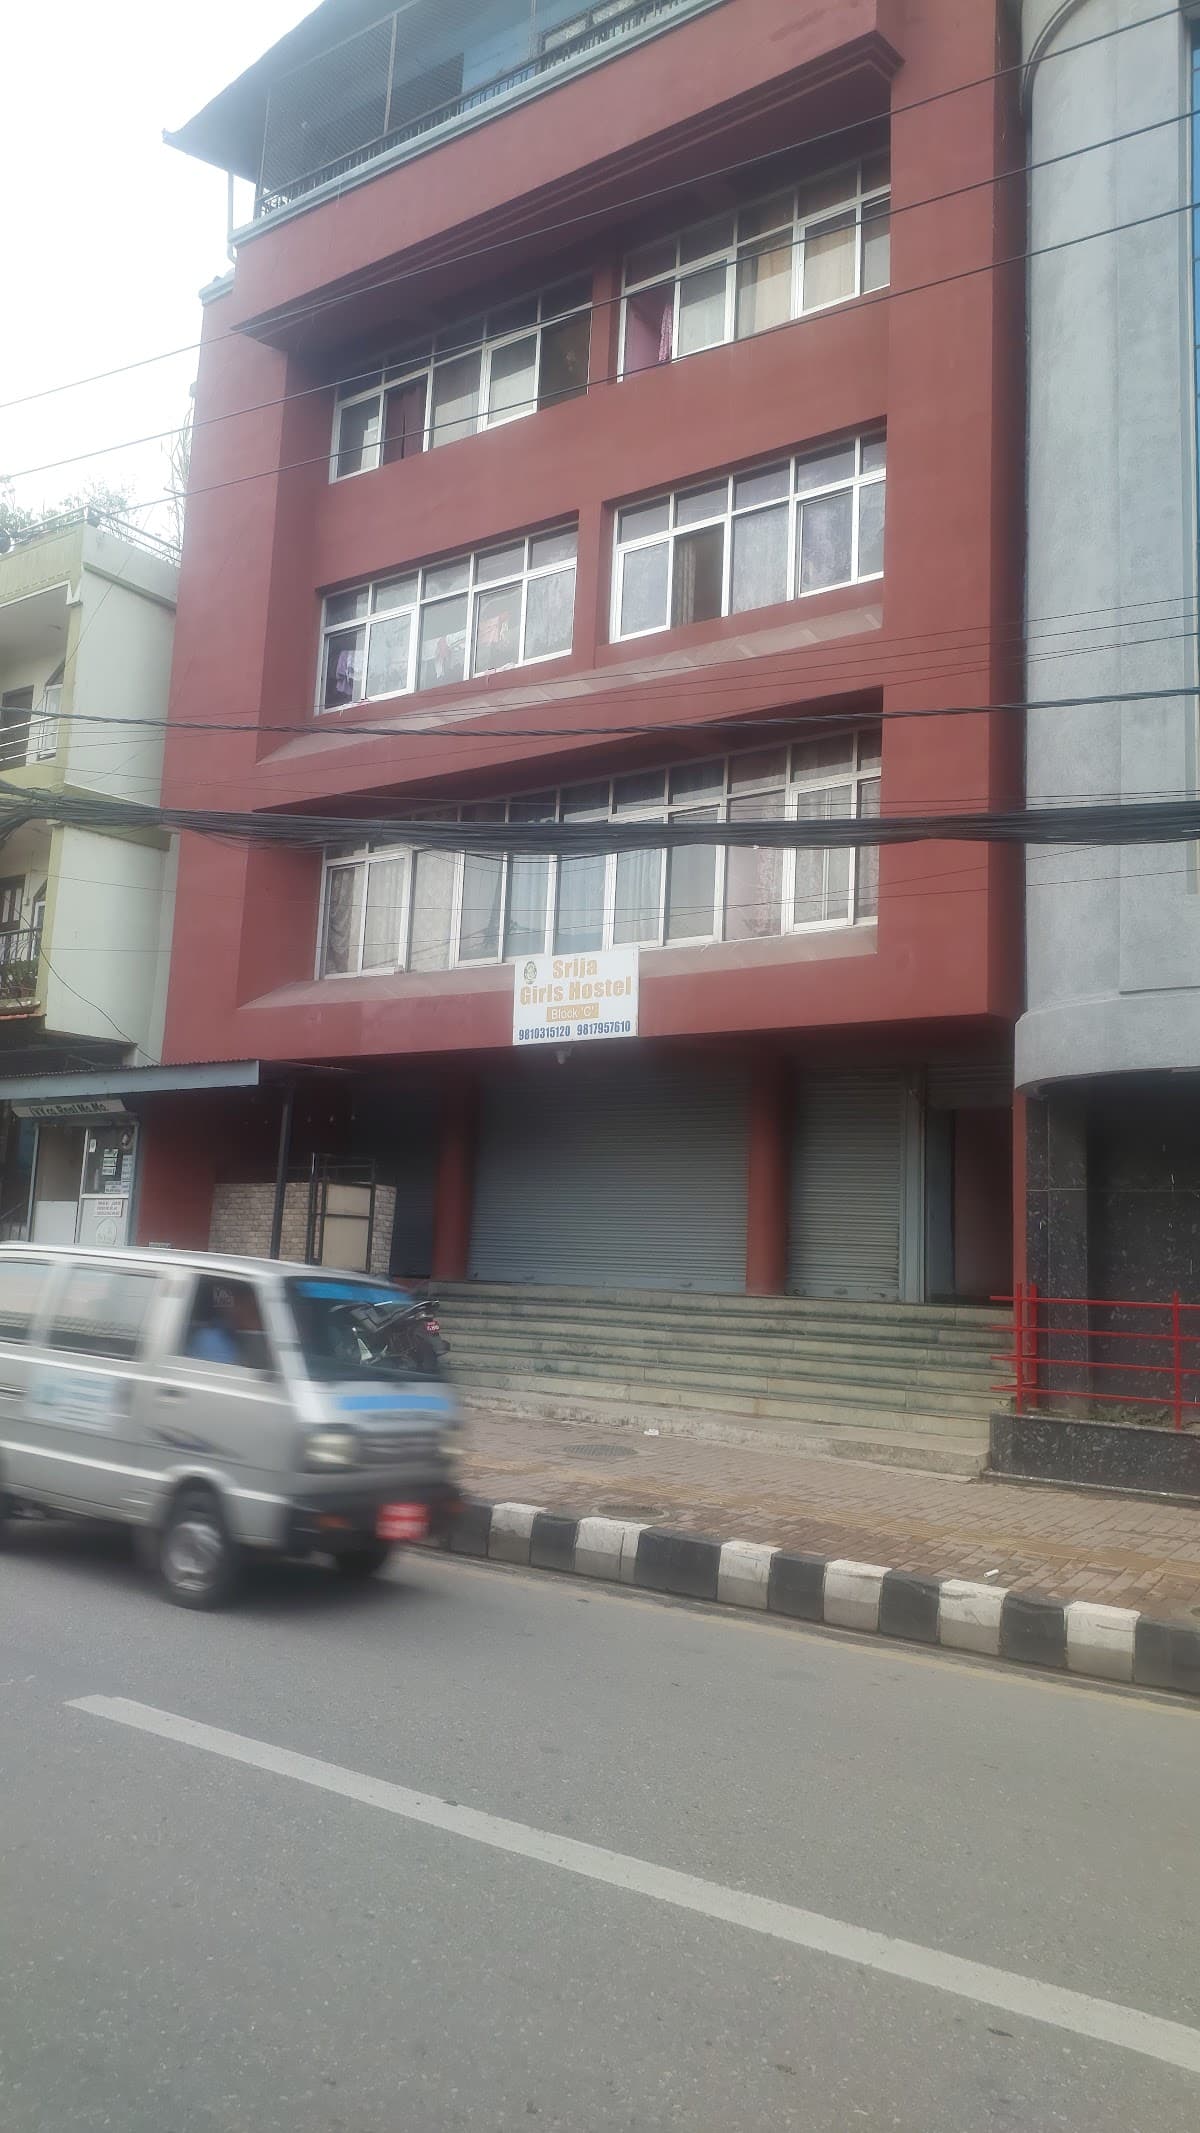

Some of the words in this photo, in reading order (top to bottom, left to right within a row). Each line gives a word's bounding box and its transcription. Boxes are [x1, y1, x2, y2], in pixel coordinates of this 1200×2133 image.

[553, 958, 597, 978] Srija
[520, 984, 563, 1005] Girls
[569, 976, 631, 1000] Hostel
[551, 1007, 578, 1019] Block
[519, 1025, 571, 1040] 9810315120
[577, 1020, 631, 1035] 9817957610
